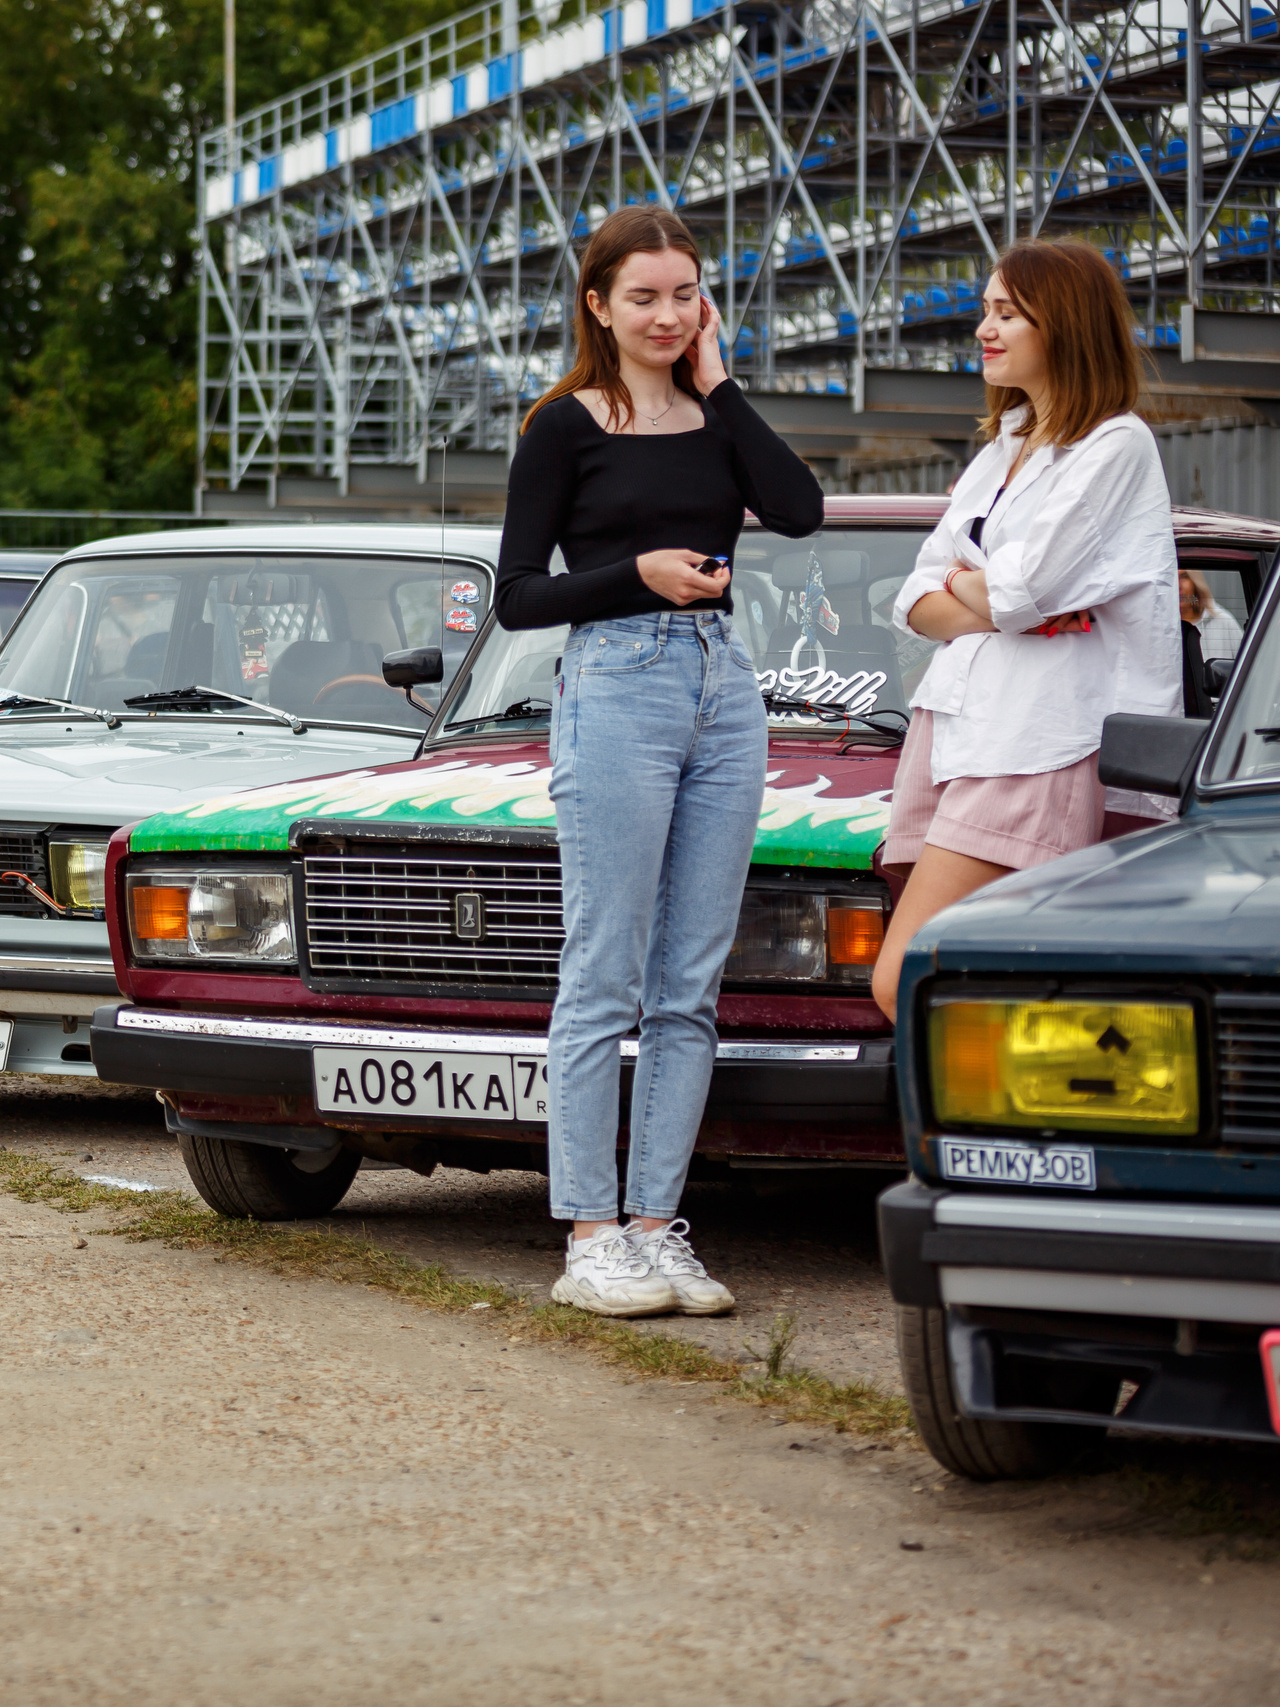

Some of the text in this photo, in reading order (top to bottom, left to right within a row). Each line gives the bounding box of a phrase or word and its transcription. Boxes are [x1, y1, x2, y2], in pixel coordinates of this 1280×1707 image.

[332, 1057, 549, 1112] А081КА 7
[949, 1147, 1087, 1184] РЕМКУЗОВ
